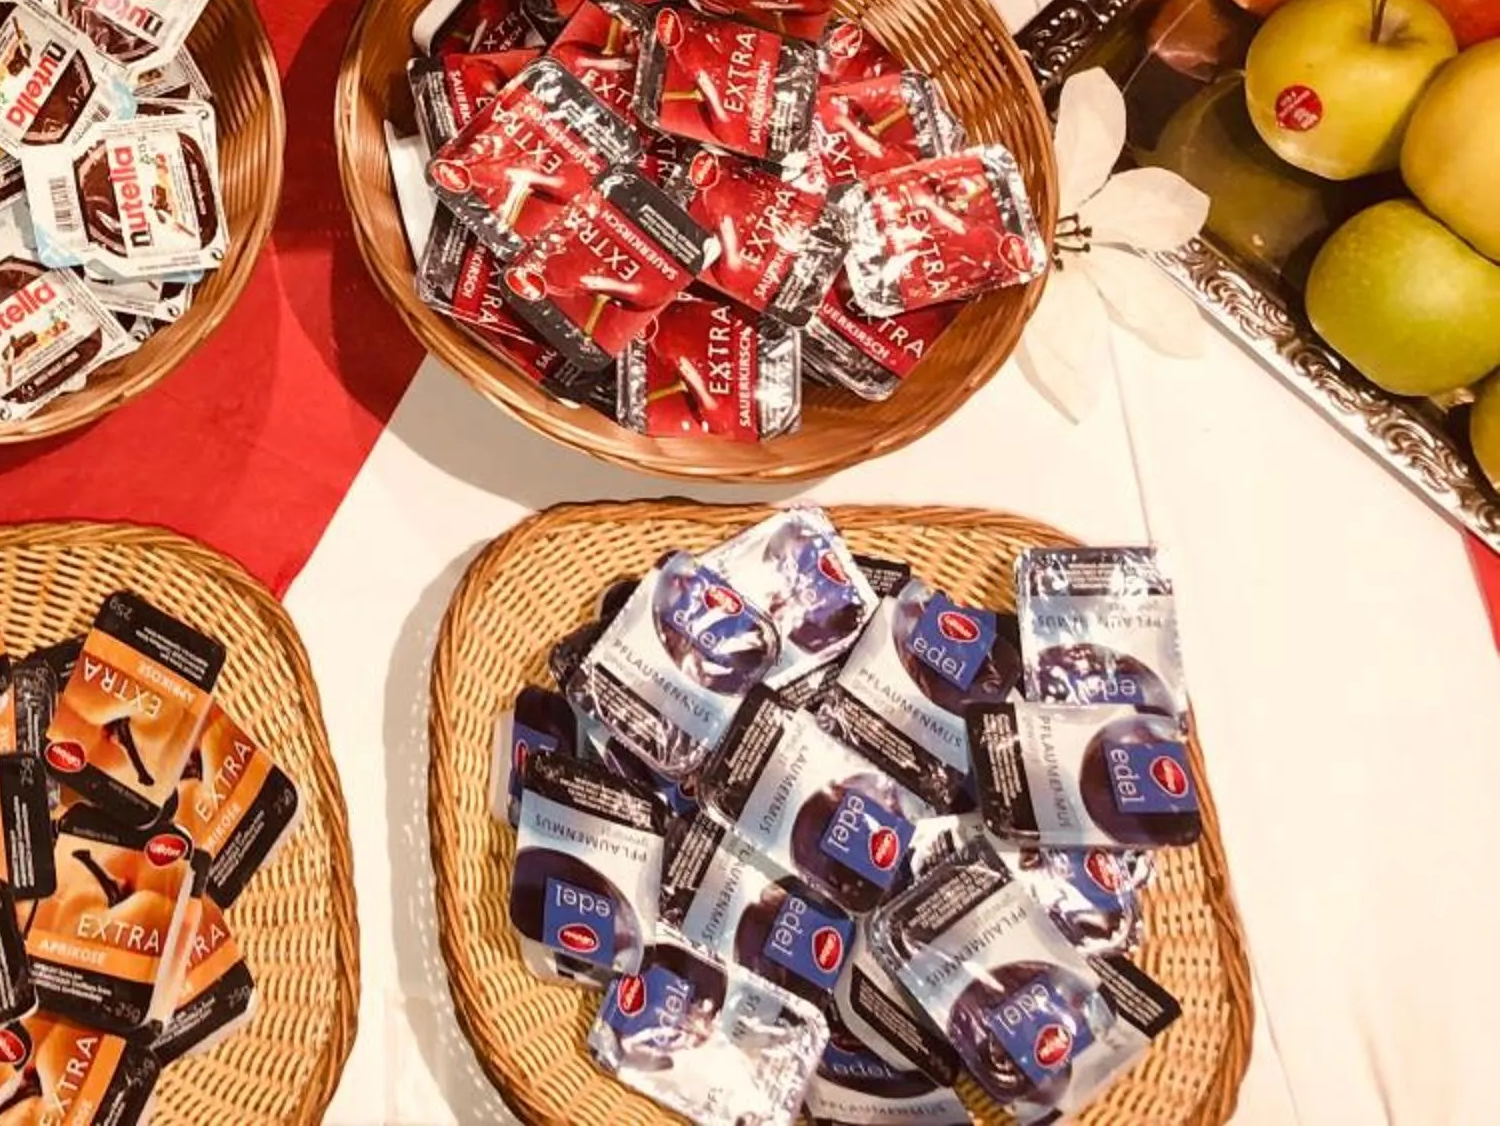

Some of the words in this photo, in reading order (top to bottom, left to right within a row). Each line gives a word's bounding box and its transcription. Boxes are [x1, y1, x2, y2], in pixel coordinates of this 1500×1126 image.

[483, 11, 523, 52] XTR
[6, 39, 68, 127] nutella
[581, 69, 631, 105] EXT
[724, 32, 757, 114] EXTRA
[491, 101, 564, 174] EXTRA
[112, 145, 151, 249] nutella
[741, 189, 797, 267] EXTRA
[563, 206, 642, 282] EXTRA
[600, 209, 680, 281] SAUERKIRSCH
[708, 304, 732, 395] EXTRA
[821, 302, 892, 361] UERKIRSCH
[739, 326, 755, 427] SAUERKIRSCH
[82, 656, 164, 718] EXTRA
[912, 635, 968, 682] edel
[860, 669, 964, 749] PFLAUMENMUS
[194, 740, 252, 823] EXTRA
[1110, 748, 1146, 804] edel
[534, 812, 649, 863] PFLAUMENMUS
[827, 795, 866, 853] edel
[555, 884, 612, 917] edel
[772, 896, 808, 958] edel
[77, 914, 161, 954] EXTRA
[995, 983, 1051, 1036] edel
